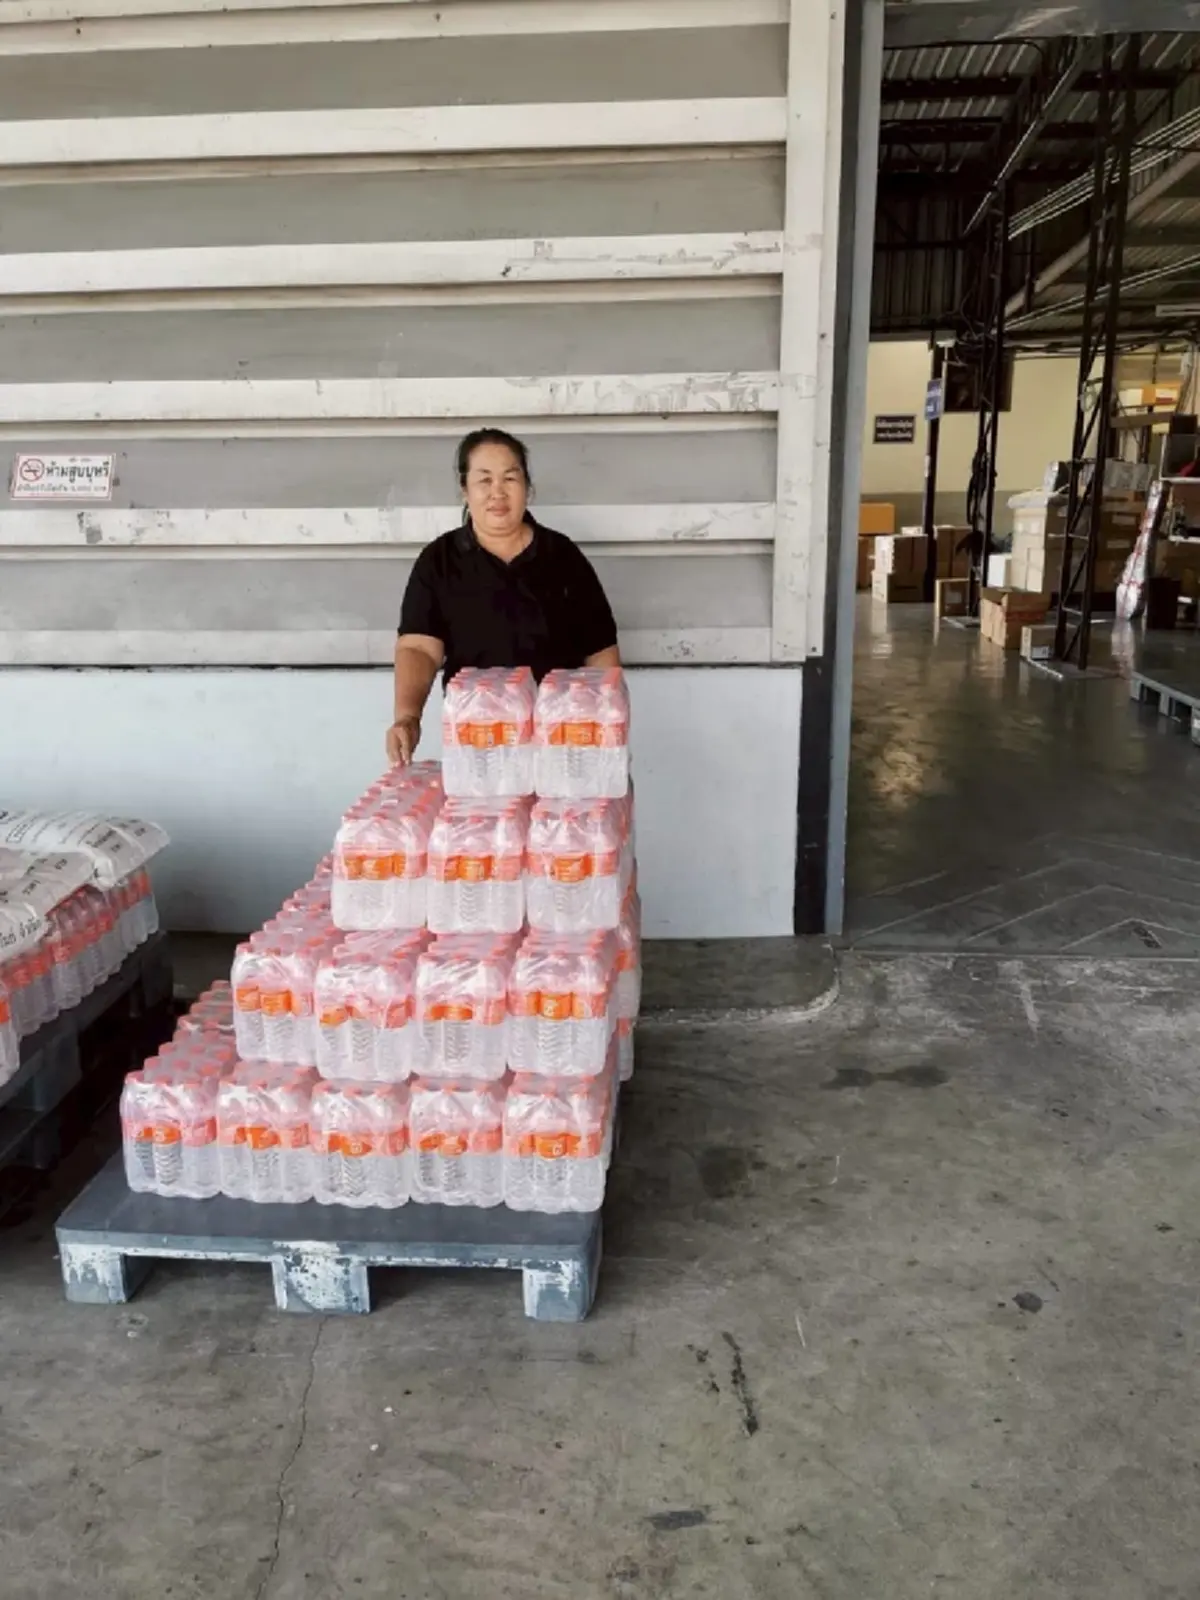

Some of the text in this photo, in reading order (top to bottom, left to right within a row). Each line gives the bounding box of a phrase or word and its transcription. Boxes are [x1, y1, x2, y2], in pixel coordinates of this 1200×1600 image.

[46, 460, 110, 483] ห้ามสูบบุหรี่
